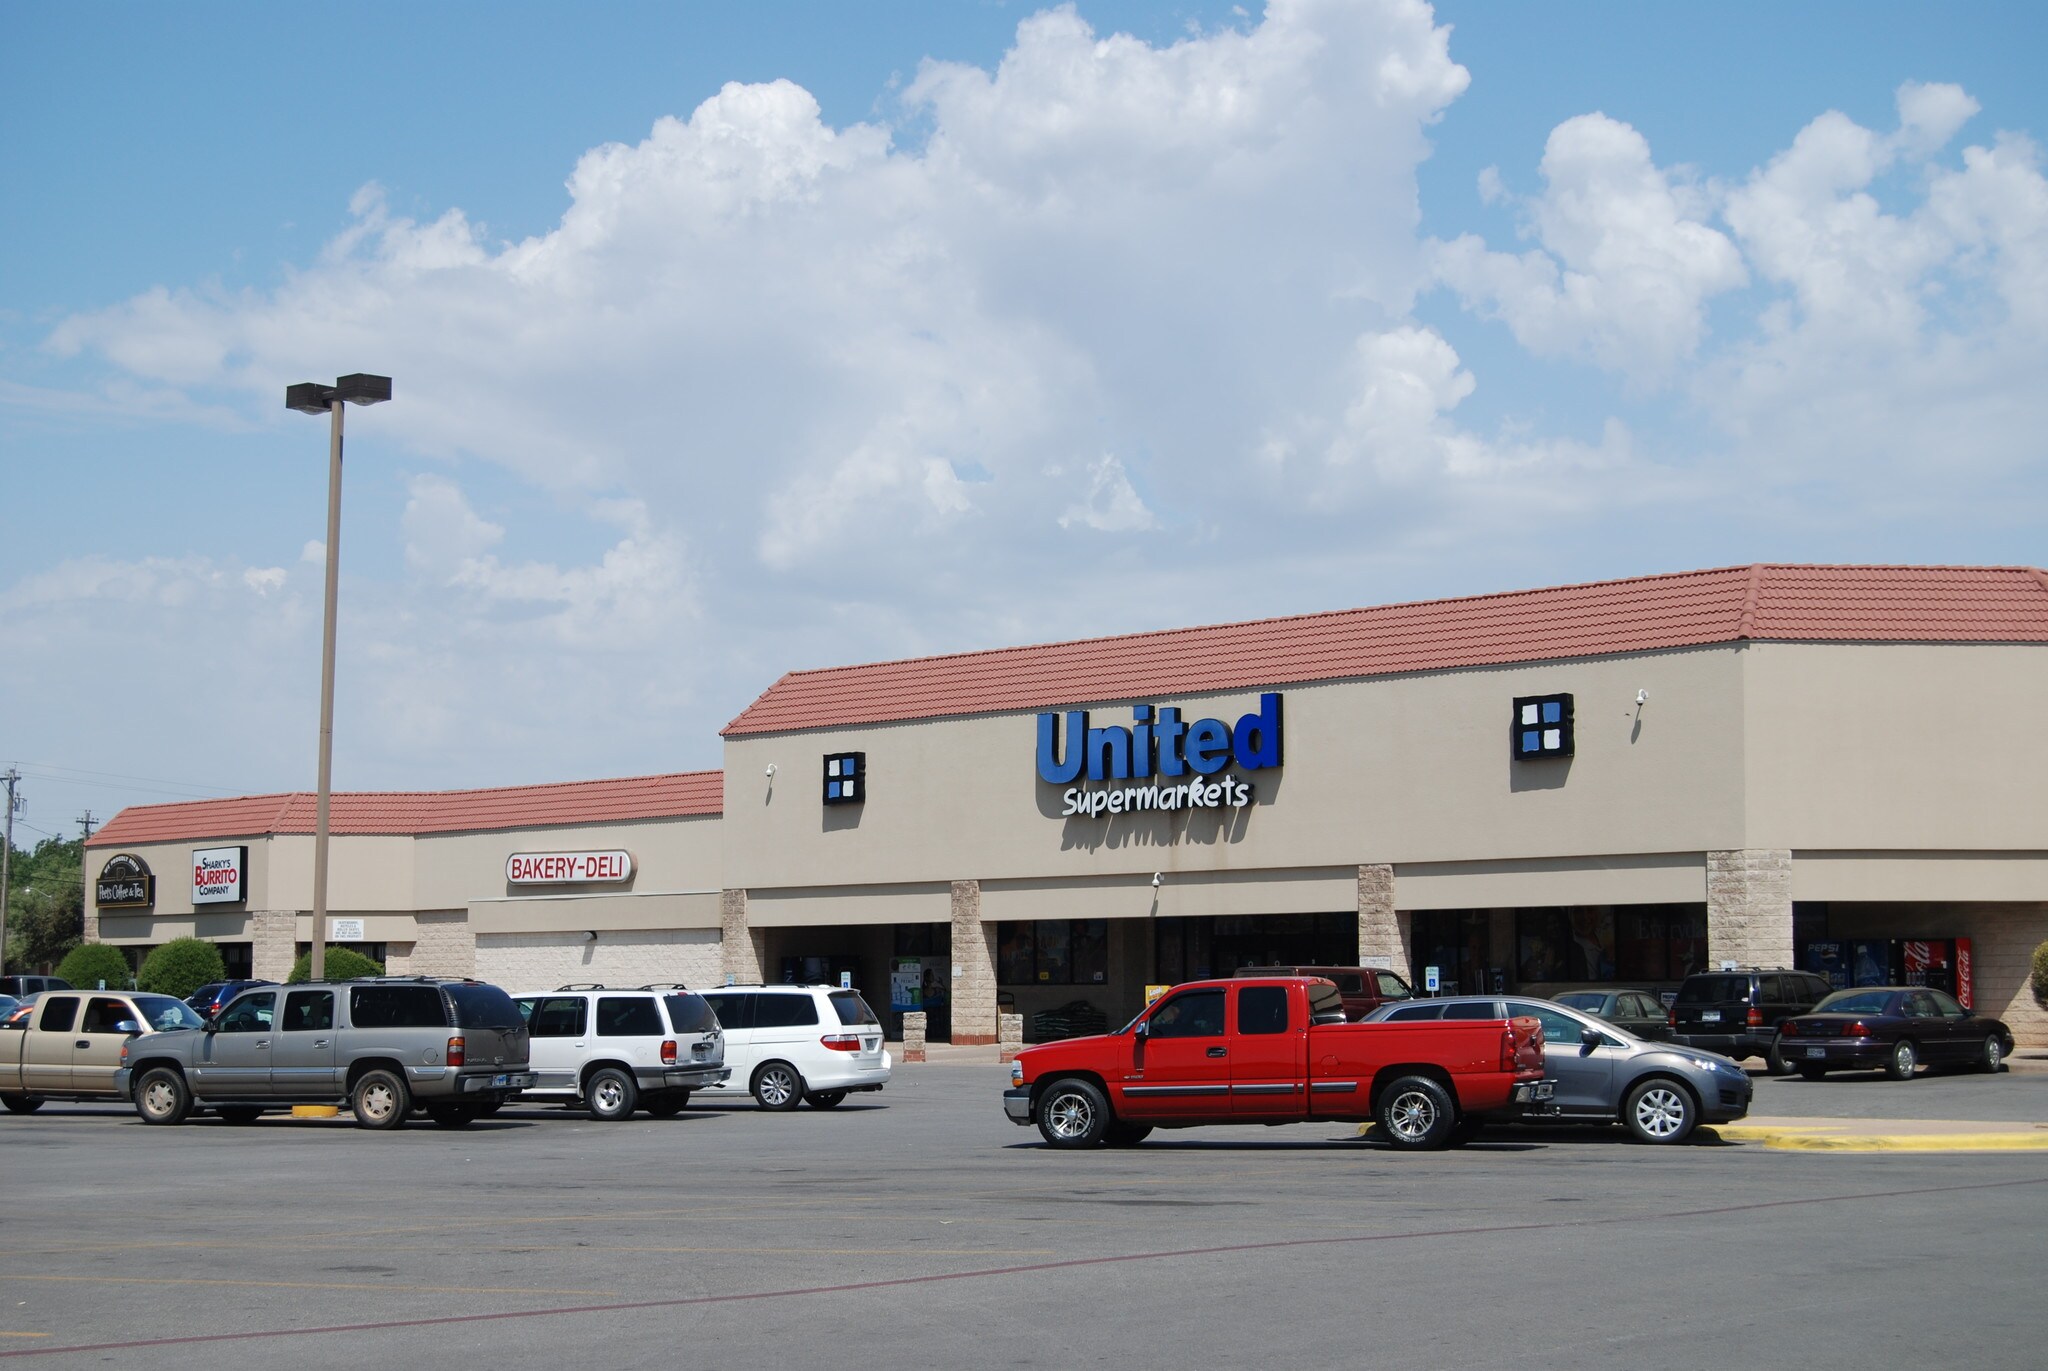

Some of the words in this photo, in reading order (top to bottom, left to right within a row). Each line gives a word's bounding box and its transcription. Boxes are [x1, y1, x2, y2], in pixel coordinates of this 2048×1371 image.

[1037, 693, 1283, 784] United
[1062, 774, 1250, 818] Supermarkets
[194, 865, 237, 886] BURRITO
[511, 856, 623, 879] BAKERY-DELI
[112, 884, 129, 901] Coffee
[128, 888, 134, 897] &
[132, 882, 144, 898] Tea
[198, 884, 230, 896] COMPANY
[1807, 943, 1840, 952] PEPSI
